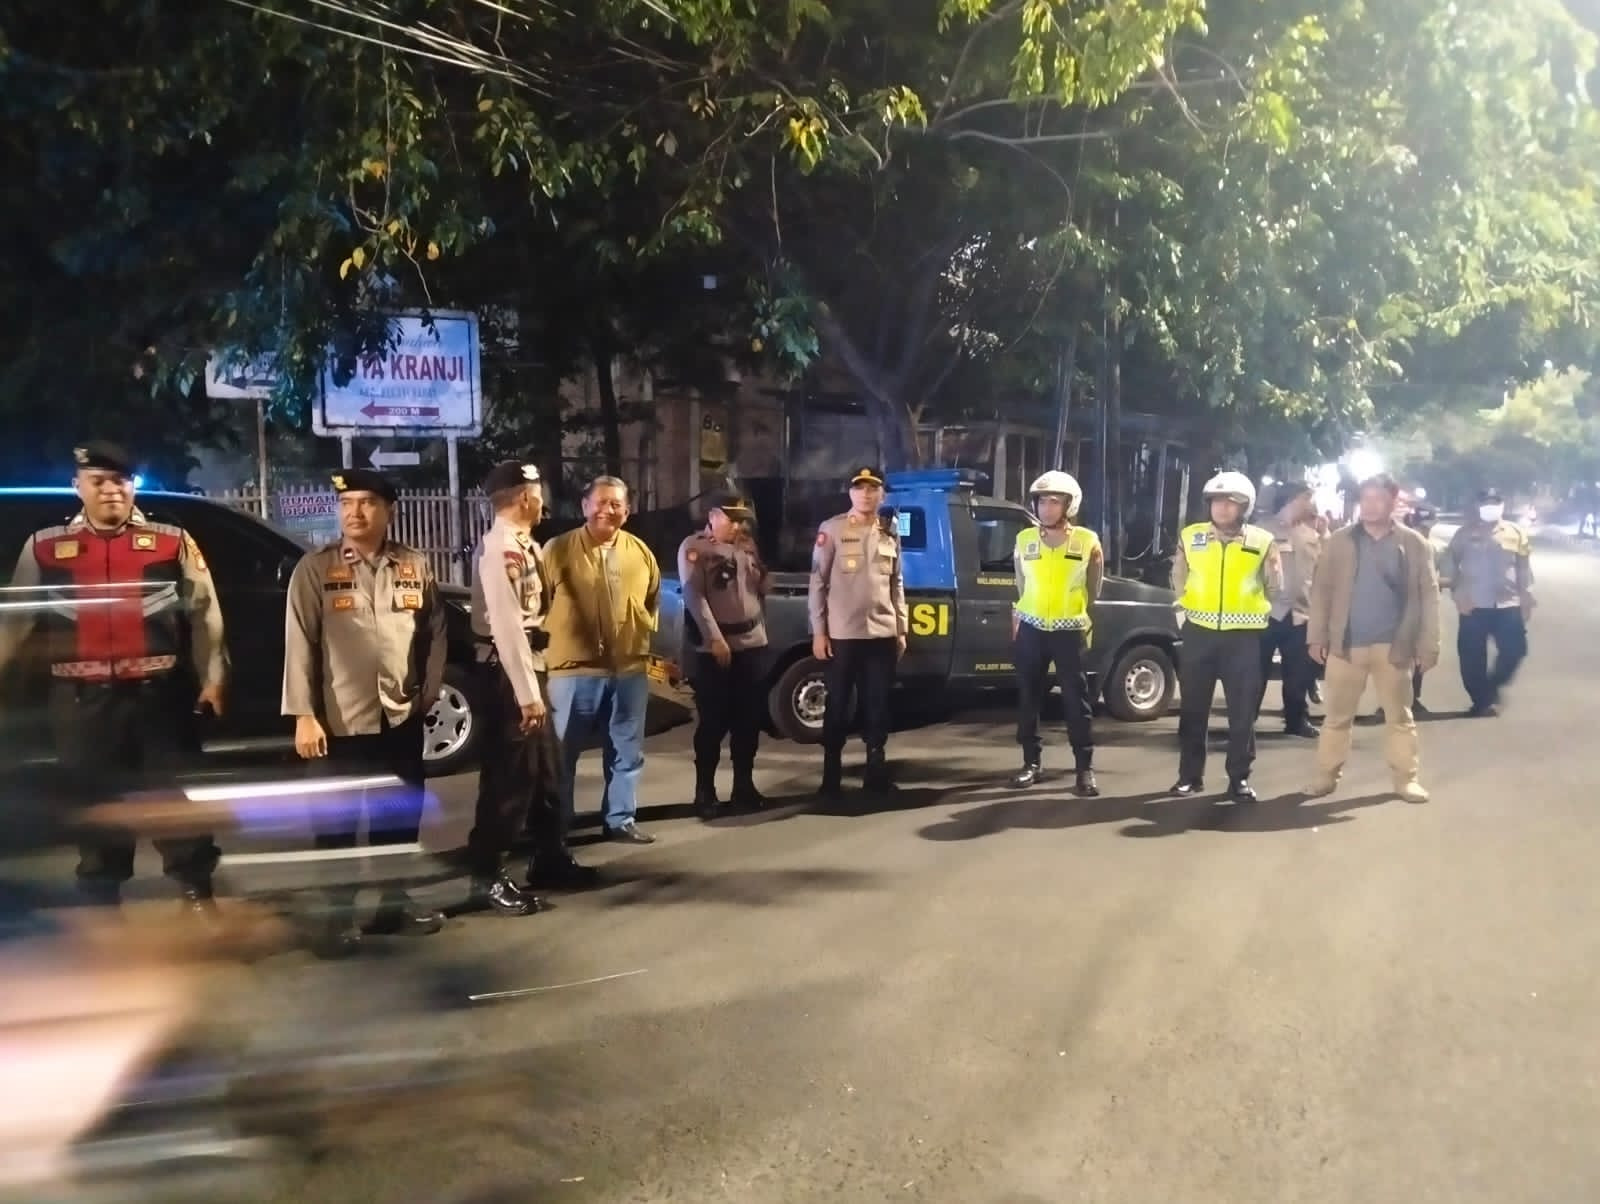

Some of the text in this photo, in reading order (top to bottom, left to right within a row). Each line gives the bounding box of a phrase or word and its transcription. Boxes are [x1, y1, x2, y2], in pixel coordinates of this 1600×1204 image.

[390, 353, 464, 381] KRANJI
[388, 407, 420, 415] 200 M
[280, 495, 336, 505] RUMAH
[281, 505, 336, 516] DIJUAL
